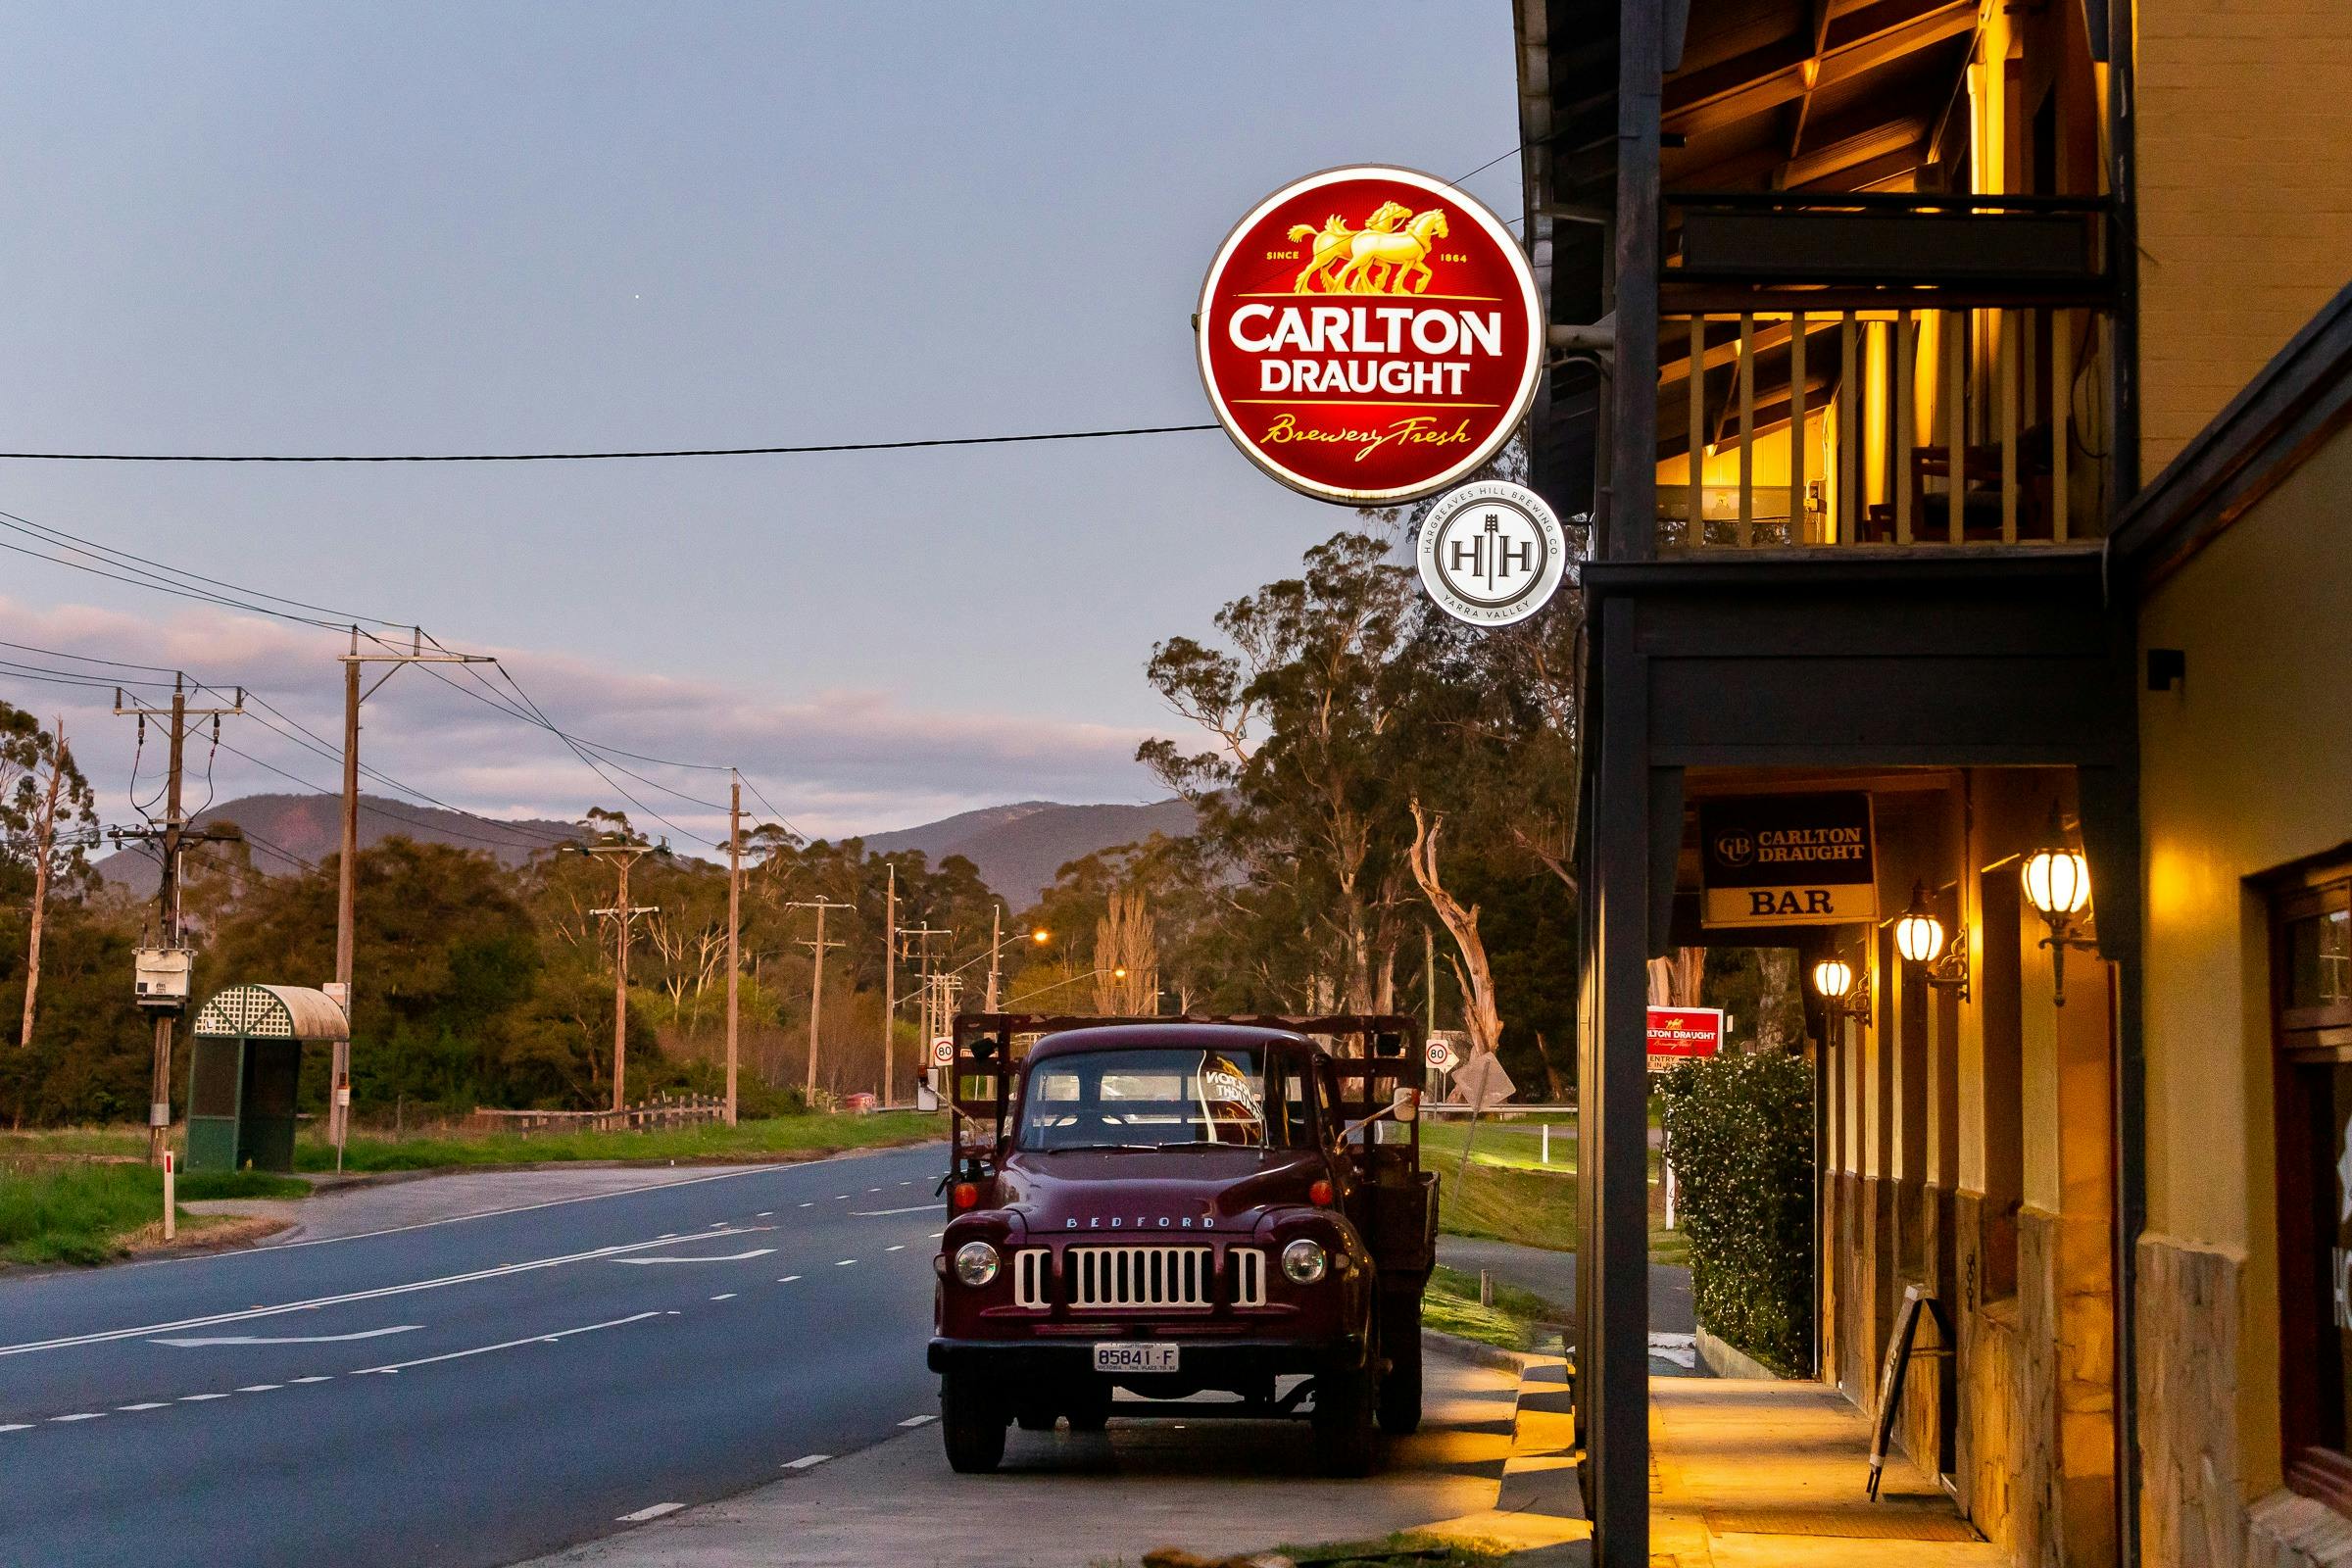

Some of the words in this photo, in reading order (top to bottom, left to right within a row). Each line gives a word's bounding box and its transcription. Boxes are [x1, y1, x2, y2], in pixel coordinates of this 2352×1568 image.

[1266, 251, 1299, 260] SINCE
[1441, 253, 1467, 264] 1864
[1228, 303, 1503, 357] CARLTON
[1260, 359, 1471, 395] DRAUGHT
[1259, 413, 1384, 463] Brewery
[1389, 416, 1471, 446] Fresh
[1424, 490, 1474, 554] HARGREAVES
[1479, 487, 1506, 496] HILL
[1511, 491, 1553, 533] BREWING
[1444, 594, 1479, 617] YARRA
[1486, 600, 1530, 618] VALLEY
[1758, 827, 1863, 846] CARLTON
[1758, 845, 1865, 862] DRAUGHT
[1748, 889, 1835, 915] BAR
[1673, 1031, 1716, 1040] DRAUGHT
[938, 1046, 952, 1056] 80
[1431, 1049, 1444, 1058] 80
[1066, 1216, 1214, 1228] BEDFORD
